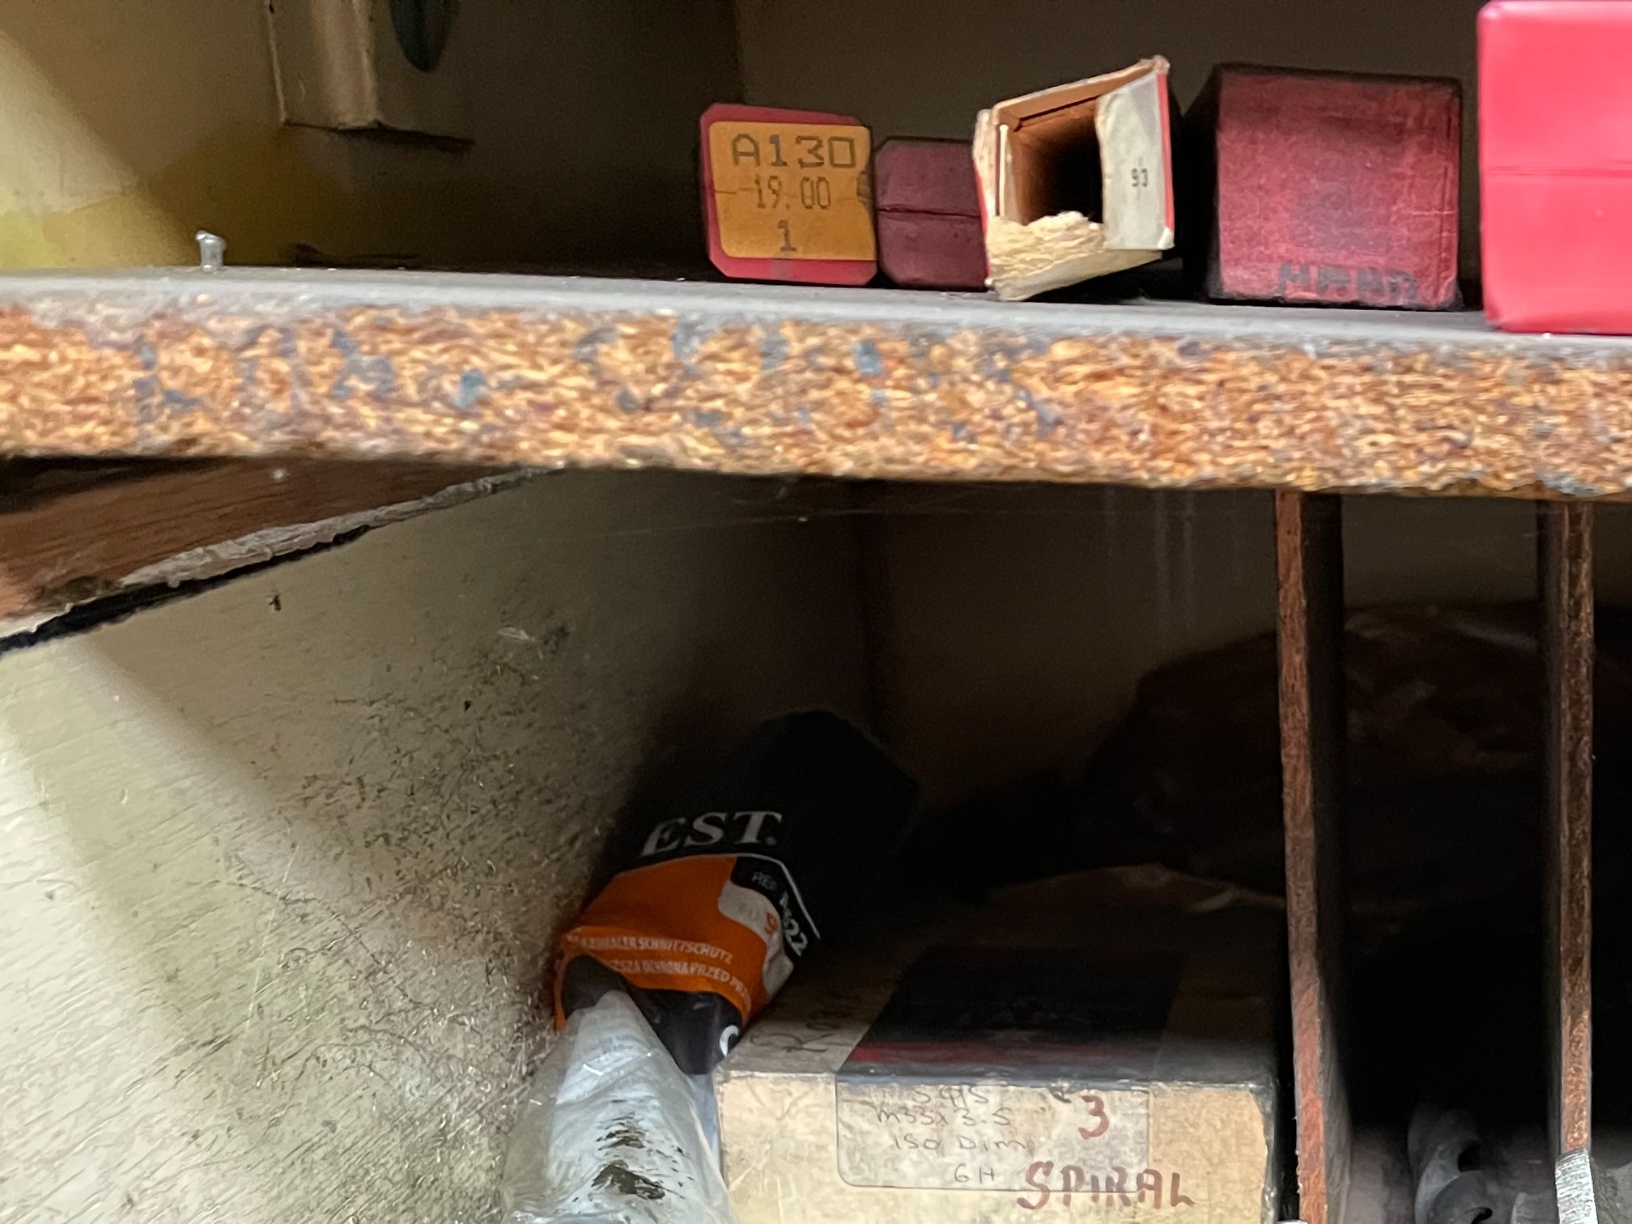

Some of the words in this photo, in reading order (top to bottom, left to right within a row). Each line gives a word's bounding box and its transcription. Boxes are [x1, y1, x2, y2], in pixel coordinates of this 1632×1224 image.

[732, 133, 856, 168] A130
[755, 173, 831, 209] 19.00
[777, 219, 797, 252] 1
[1078, 1095, 1110, 1140] 3
[1017, 1160, 1196, 1210] SPIRAL
